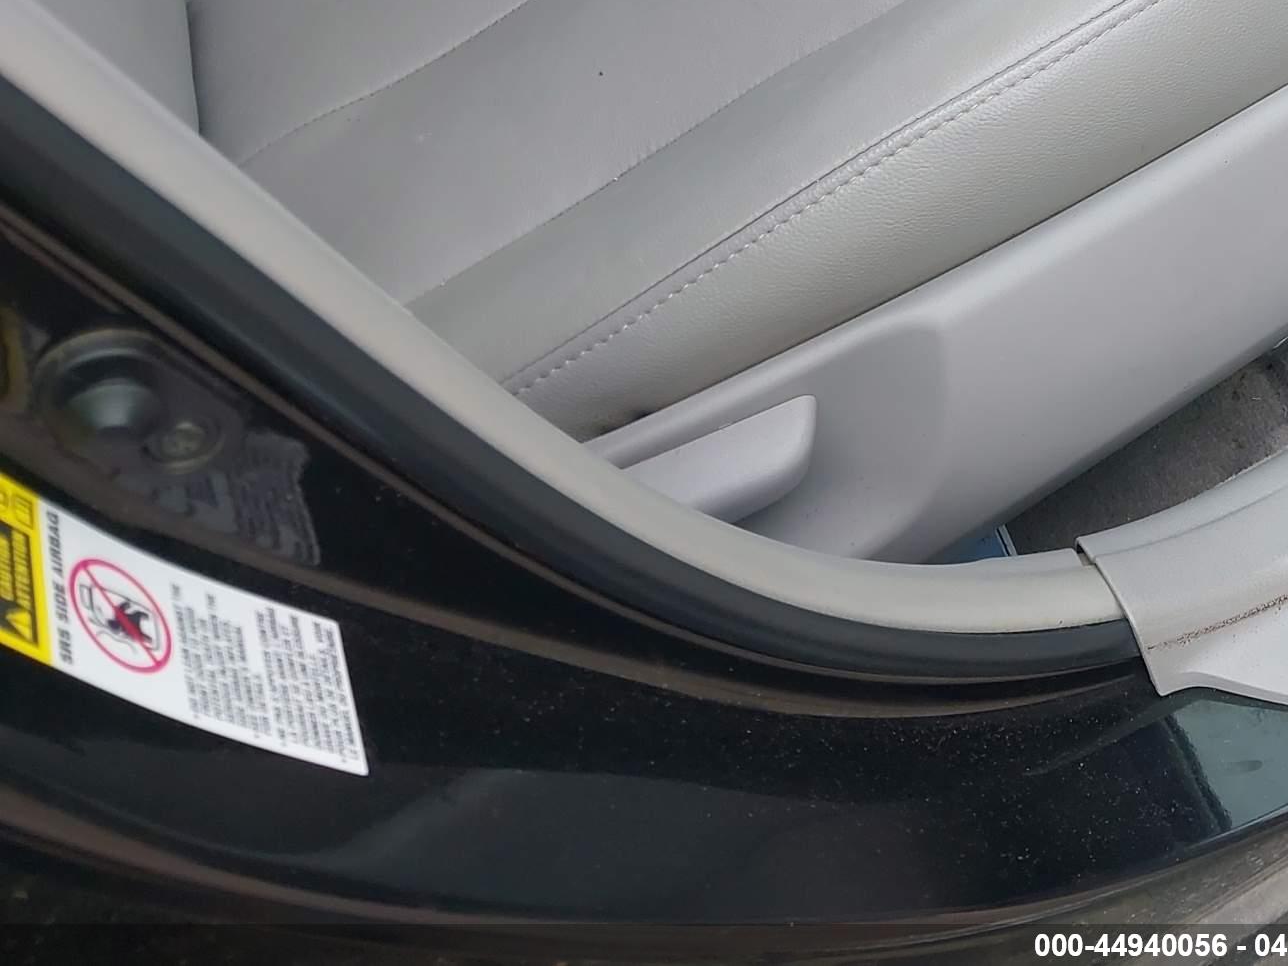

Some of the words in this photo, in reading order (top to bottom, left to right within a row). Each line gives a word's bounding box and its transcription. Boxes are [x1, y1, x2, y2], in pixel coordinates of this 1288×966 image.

[12, 530, 30, 609] ATTENTION
[47, 511, 62, 576] AIRBAG
[54, 579, 69, 624] SIDE
[58, 627, 73, 665] SRS
